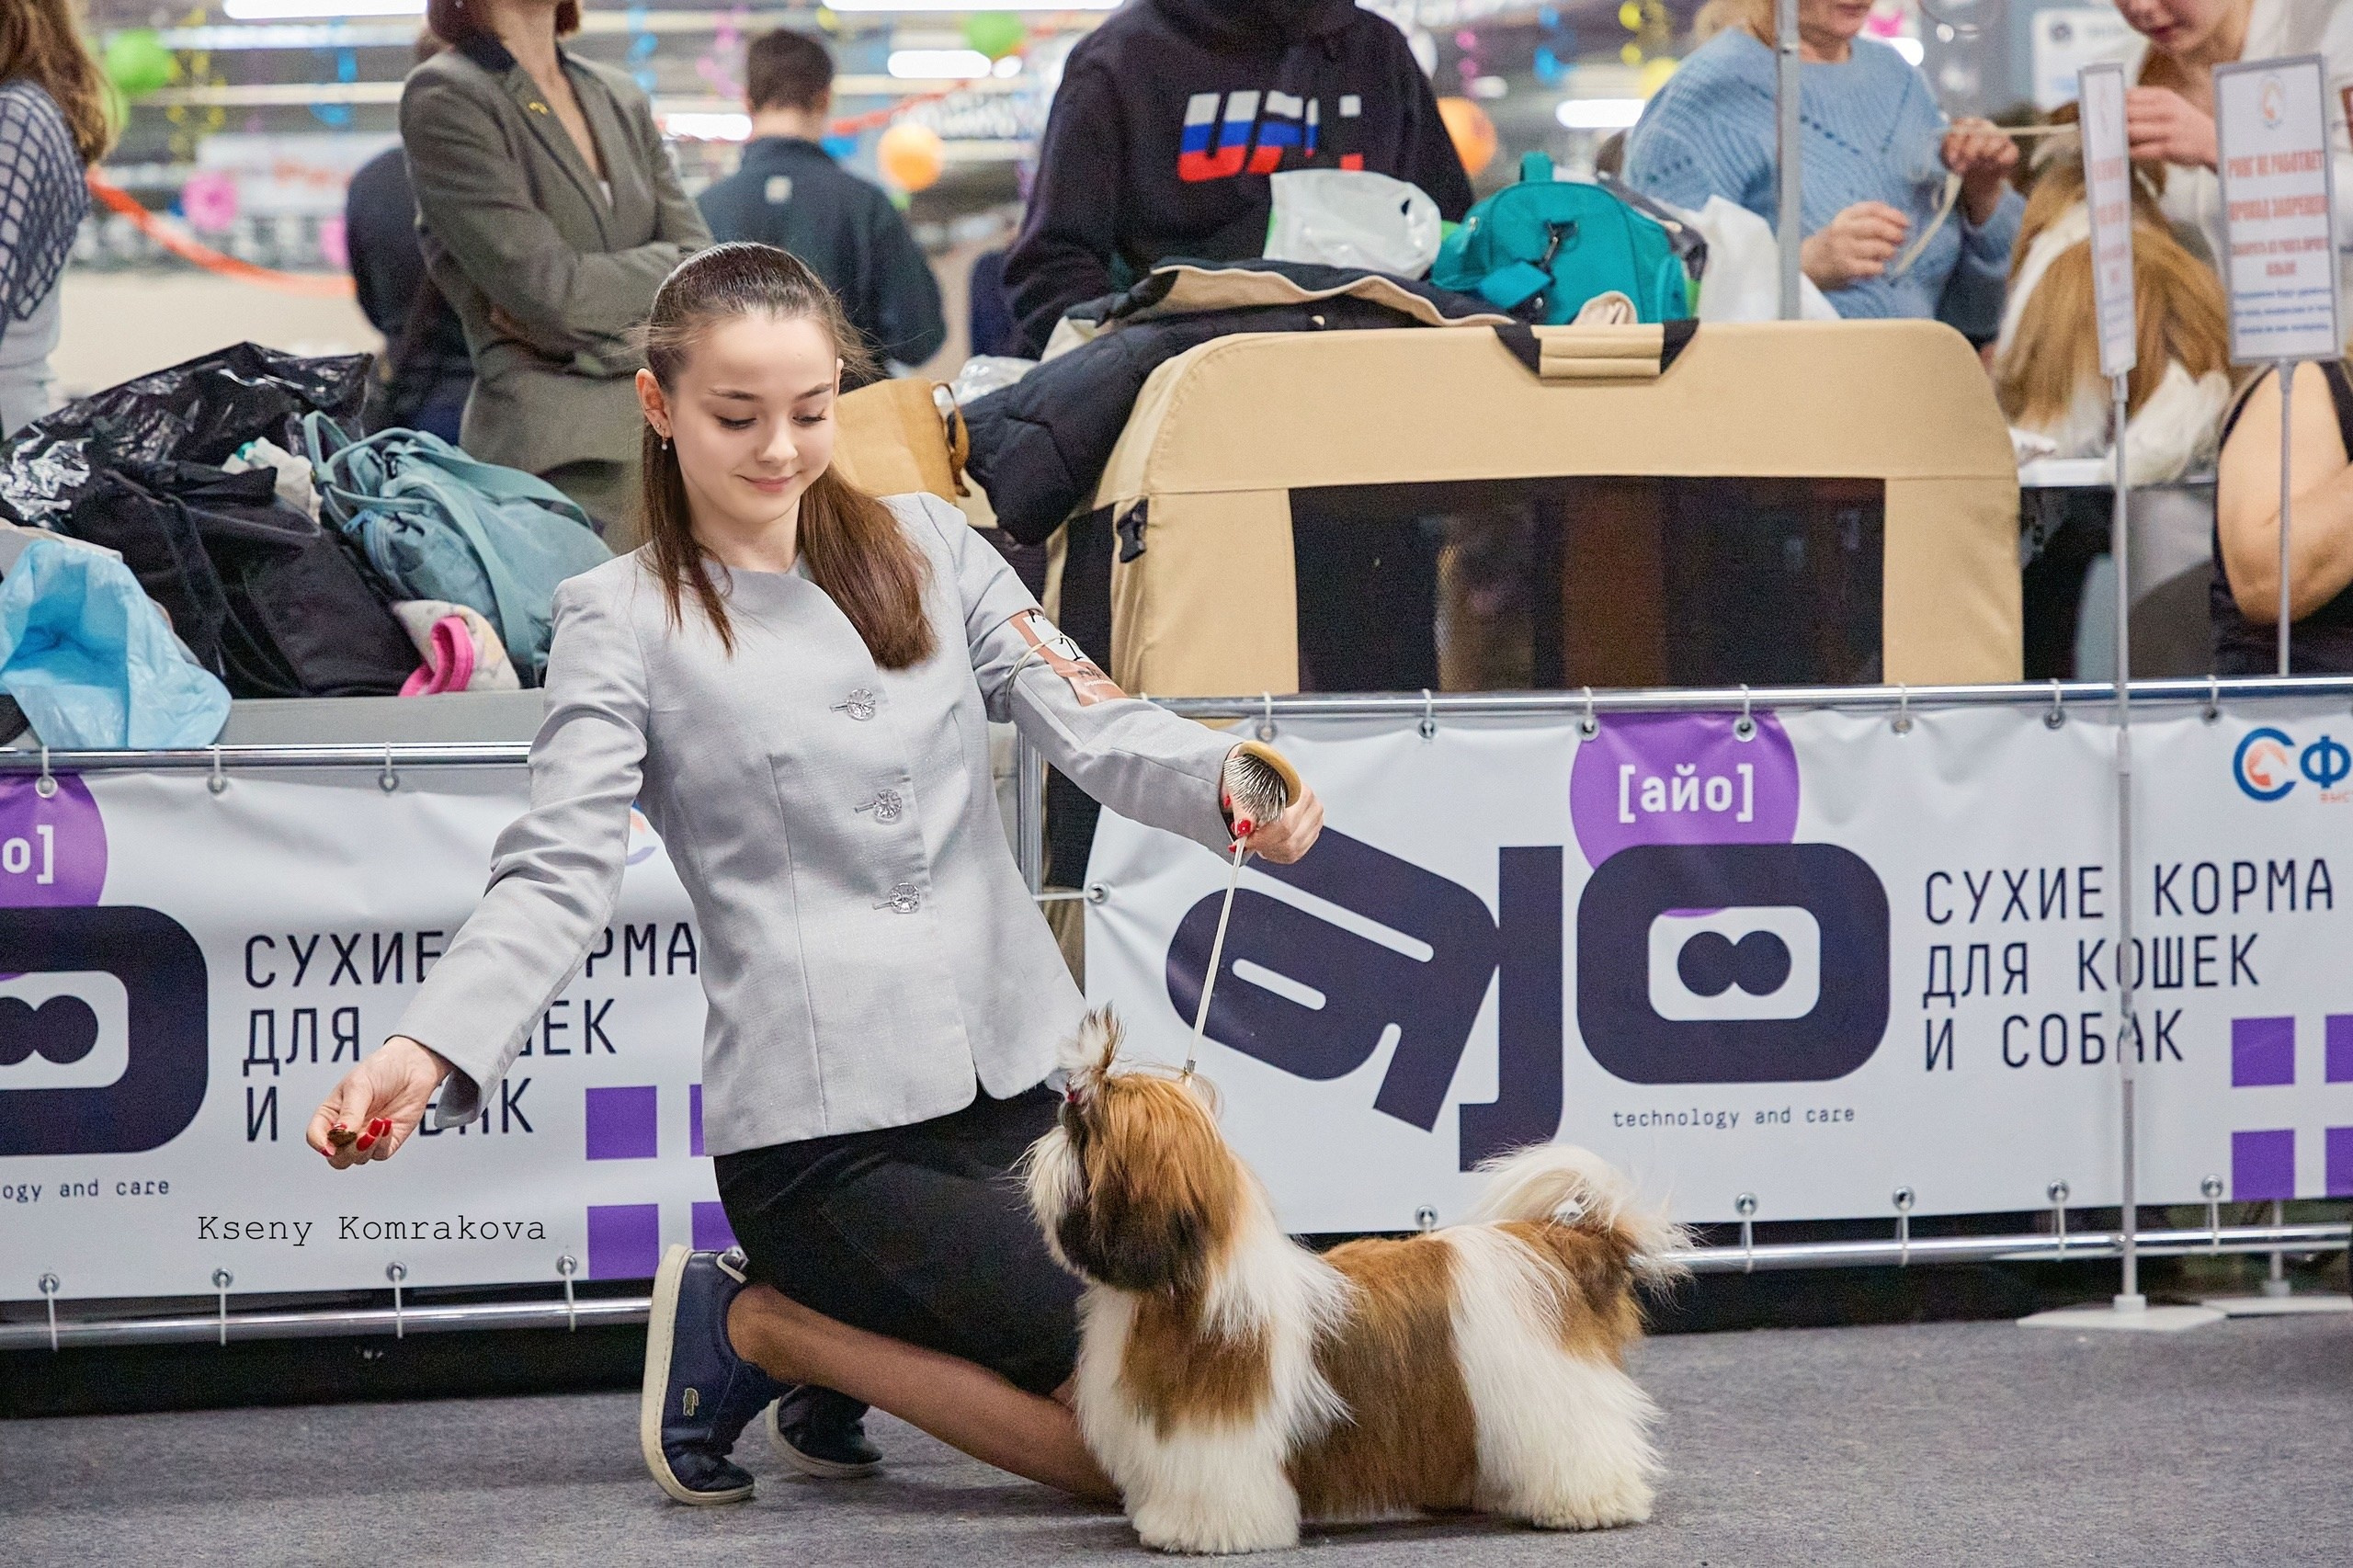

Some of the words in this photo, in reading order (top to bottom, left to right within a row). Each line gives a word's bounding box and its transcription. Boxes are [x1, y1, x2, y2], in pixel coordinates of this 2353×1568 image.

[1618, 762, 1755, 824] [айо]
[1926, 866, 2104, 926] СУХИЕ
[2154, 858, 2333, 917] КОРМА
[244, 930, 443, 988] СУХИЕ
[585, 922, 697, 978] РМА
[1922, 941, 2029, 1009] ДЛЯ
[2078, 933, 2259, 992] КОШЕК
[242, 1006, 360, 1077] ДЛЯ
[1926, 1017, 1954, 1072] И
[2002, 1008, 2184, 1069] СОБАК
[246, 1085, 278, 1142] И
[1612, 1107, 1740, 1130] technology
[1755, 1106, 1791, 1125] and
[1805, 1107, 1855, 1124] care
[59, 1178, 99, 1198] and
[116, 1176, 169, 1197] care
